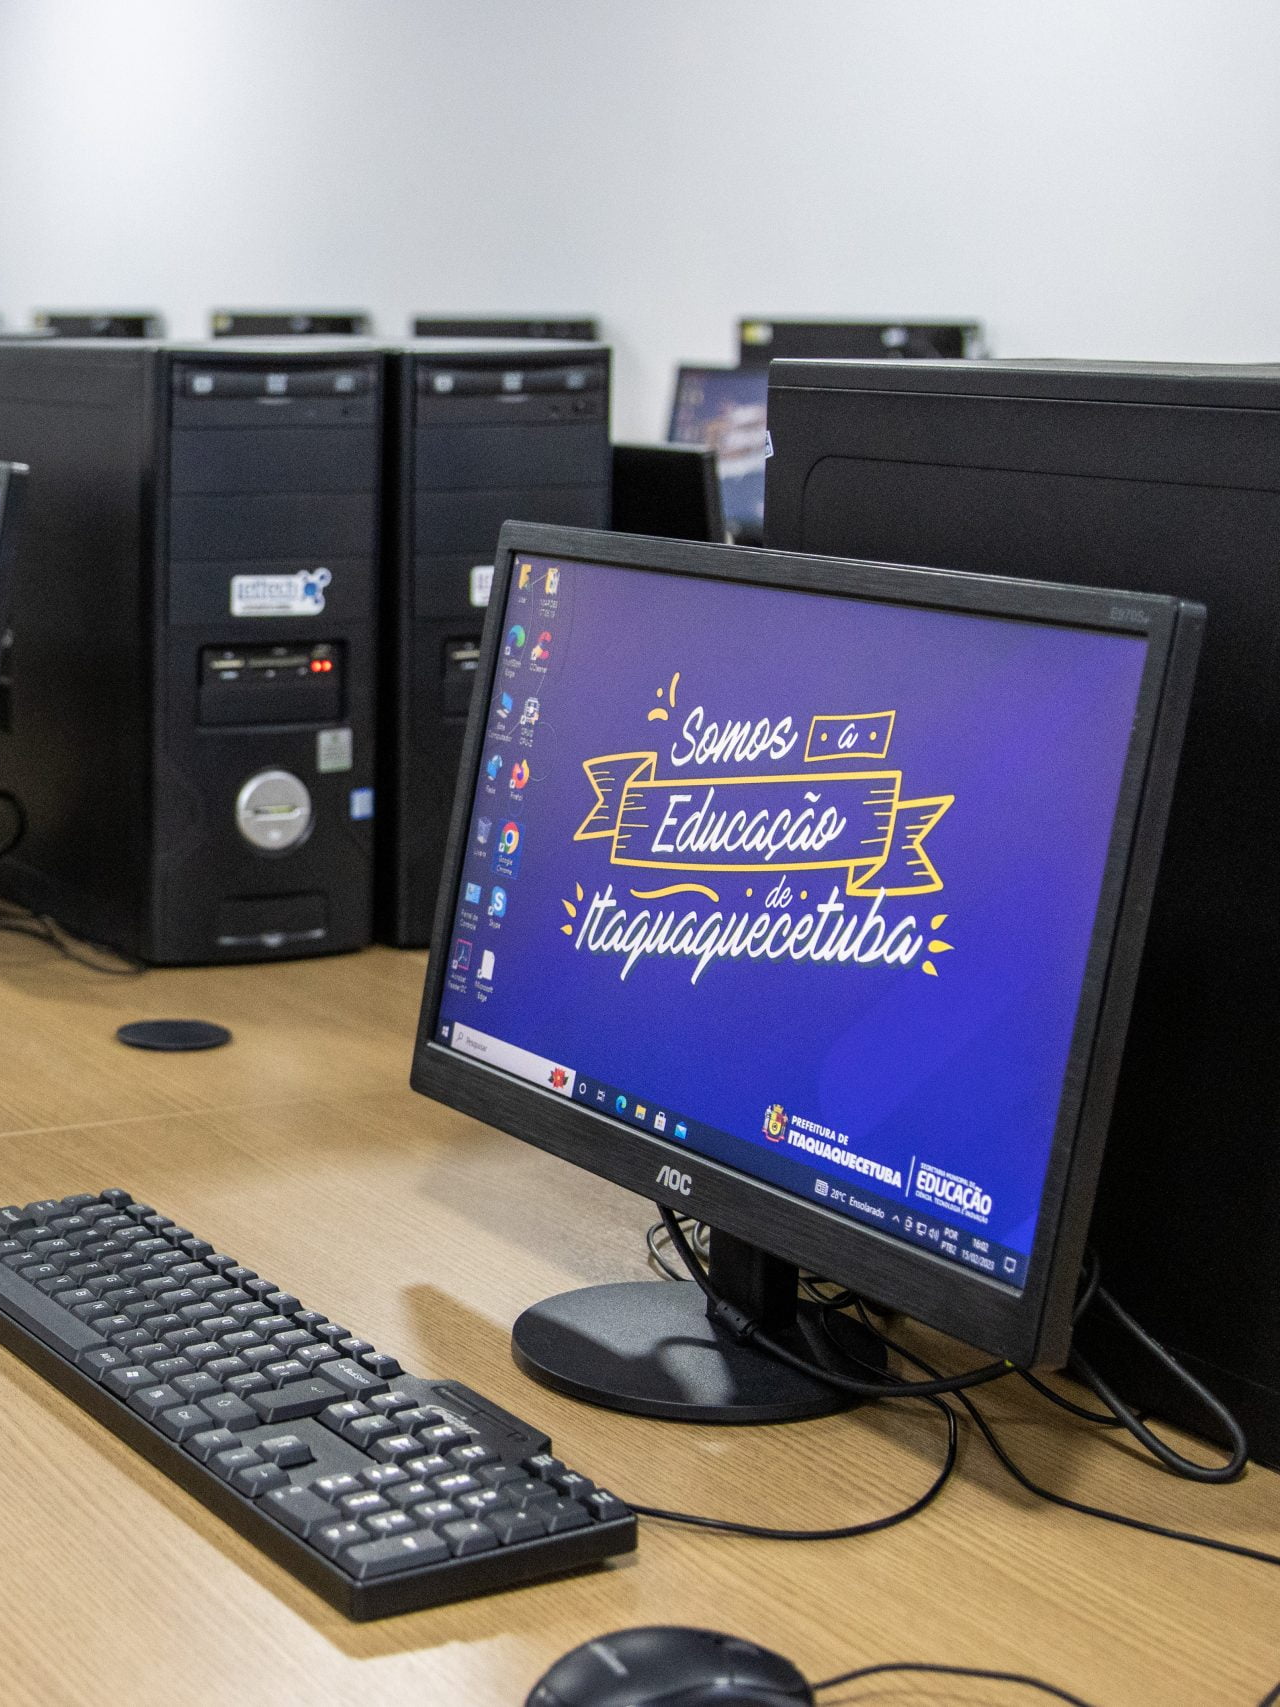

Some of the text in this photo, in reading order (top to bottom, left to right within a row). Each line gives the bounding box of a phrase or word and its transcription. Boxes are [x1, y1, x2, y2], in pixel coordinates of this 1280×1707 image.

[671, 706, 859, 767] Somos a
[651, 786, 846, 861] Educação
[765, 874, 793, 909] de
[575, 884, 923, 985] Itaquaquecetuba
[791, 1115, 849, 1145] PREFEITURA DE
[787, 1129, 902, 1188] ITAQUAQUECETUBA
[655, 1165, 692, 1196] AOC
[916, 1169, 992, 1215] EDUCAÇÃO
[849, 1196, 885, 1219] Ensolarado
[944, 1227, 959, 1241] POR
